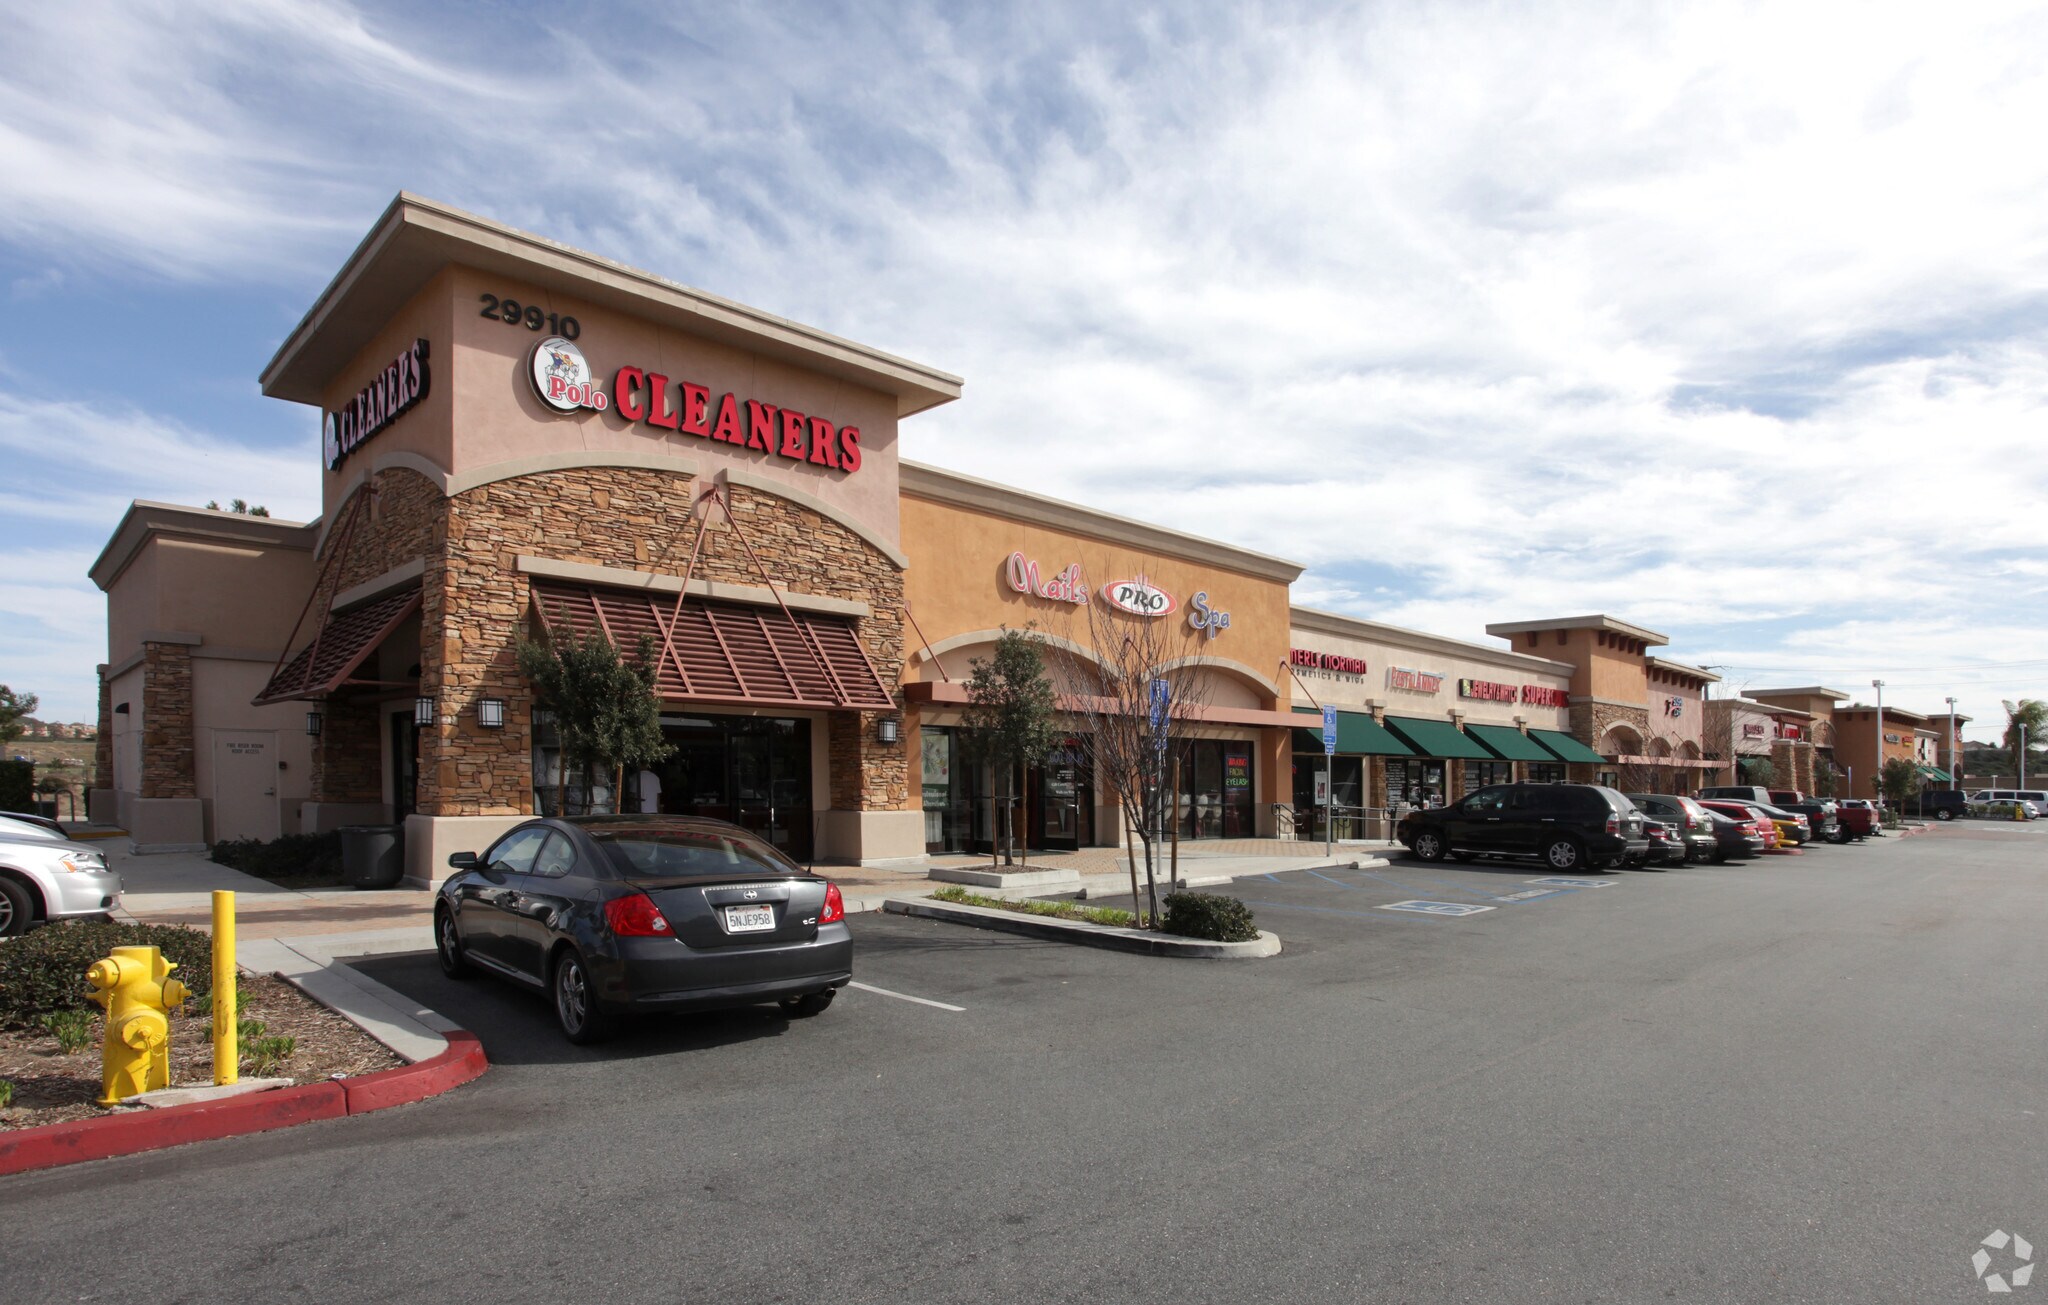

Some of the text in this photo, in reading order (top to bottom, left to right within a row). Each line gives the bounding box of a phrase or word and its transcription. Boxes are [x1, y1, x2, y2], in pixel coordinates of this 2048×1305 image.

[480, 294, 580, 341] 29910
[341, 339, 421, 454] CLEANERS
[548, 375, 608, 410] Polo
[614, 365, 862, 474] CLEANERS
[1008, 551, 1231, 640] Nails PRO Spa
[1325, 654, 1367, 674] NORMAN
[1522, 685, 1569, 707] SUPERC
[729, 913, 771, 927] 5NJE958
